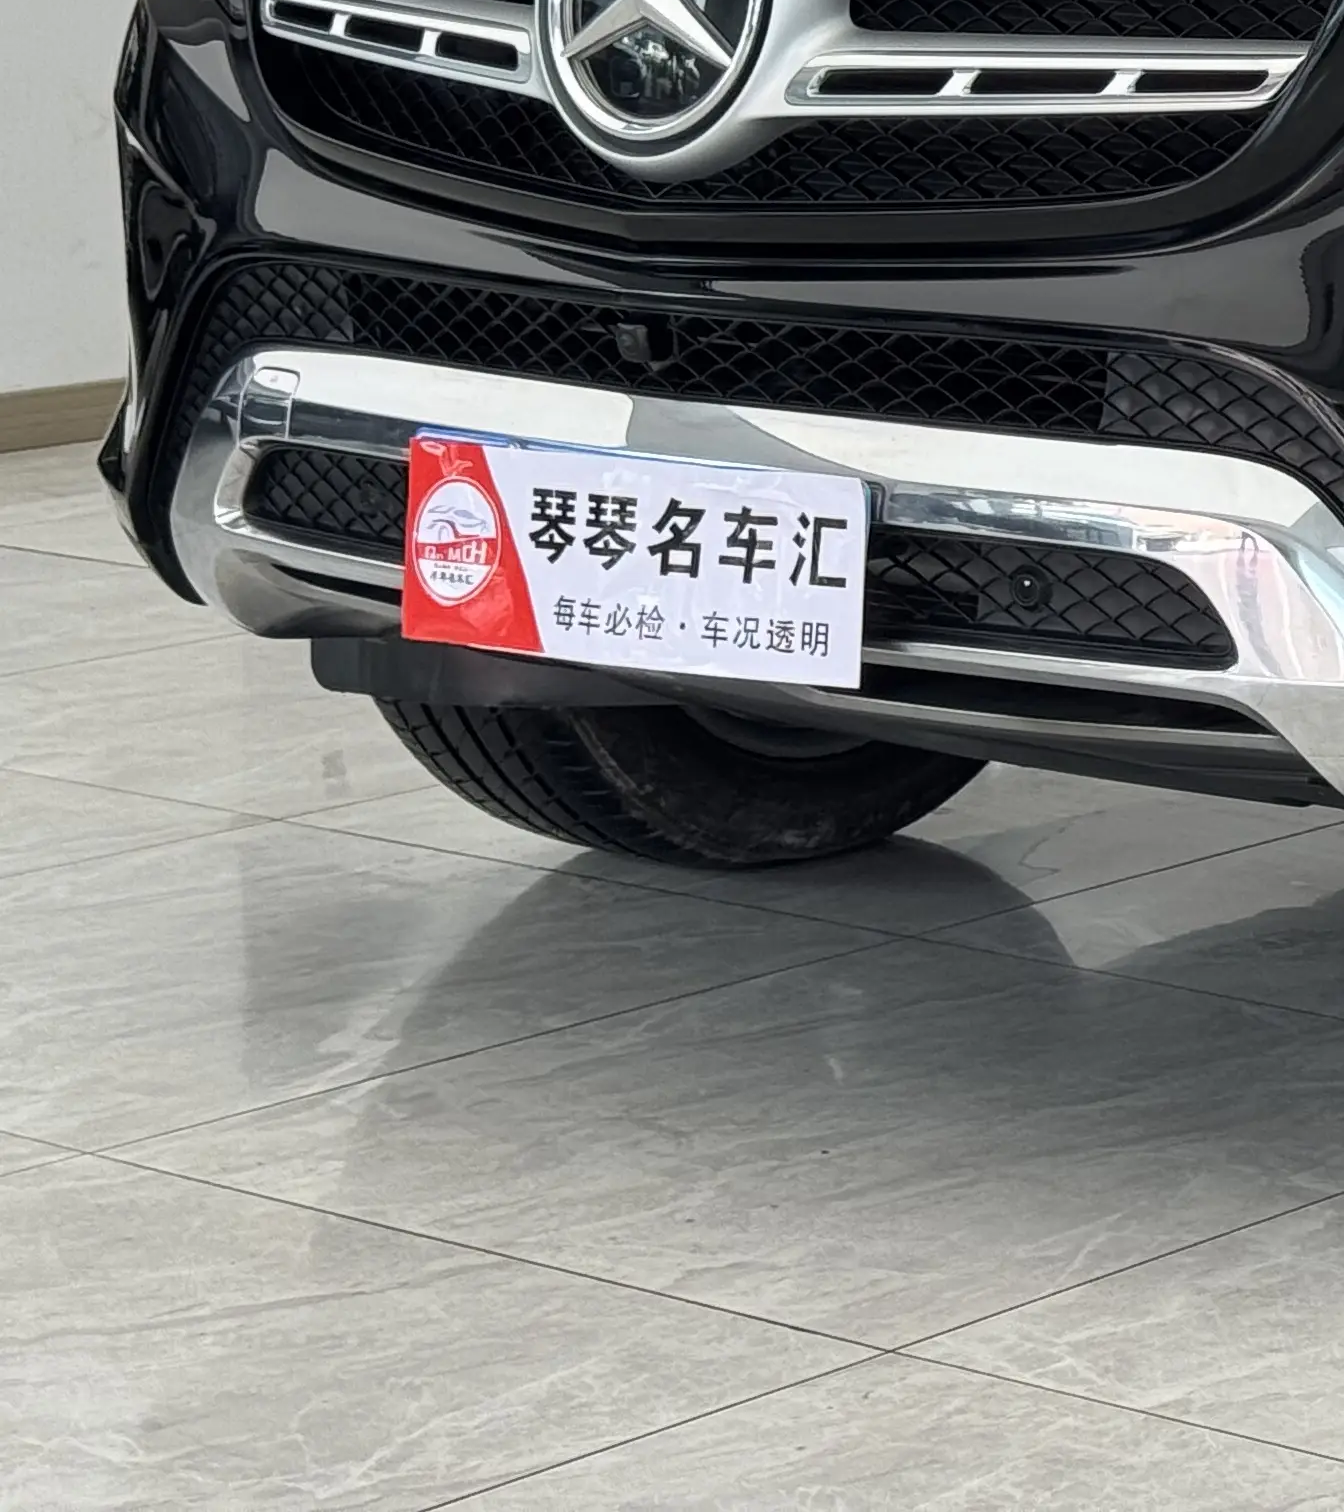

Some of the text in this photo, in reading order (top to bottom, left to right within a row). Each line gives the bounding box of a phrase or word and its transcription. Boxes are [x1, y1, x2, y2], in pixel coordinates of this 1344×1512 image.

[528, 487, 848, 589] 琴琴名车汇
